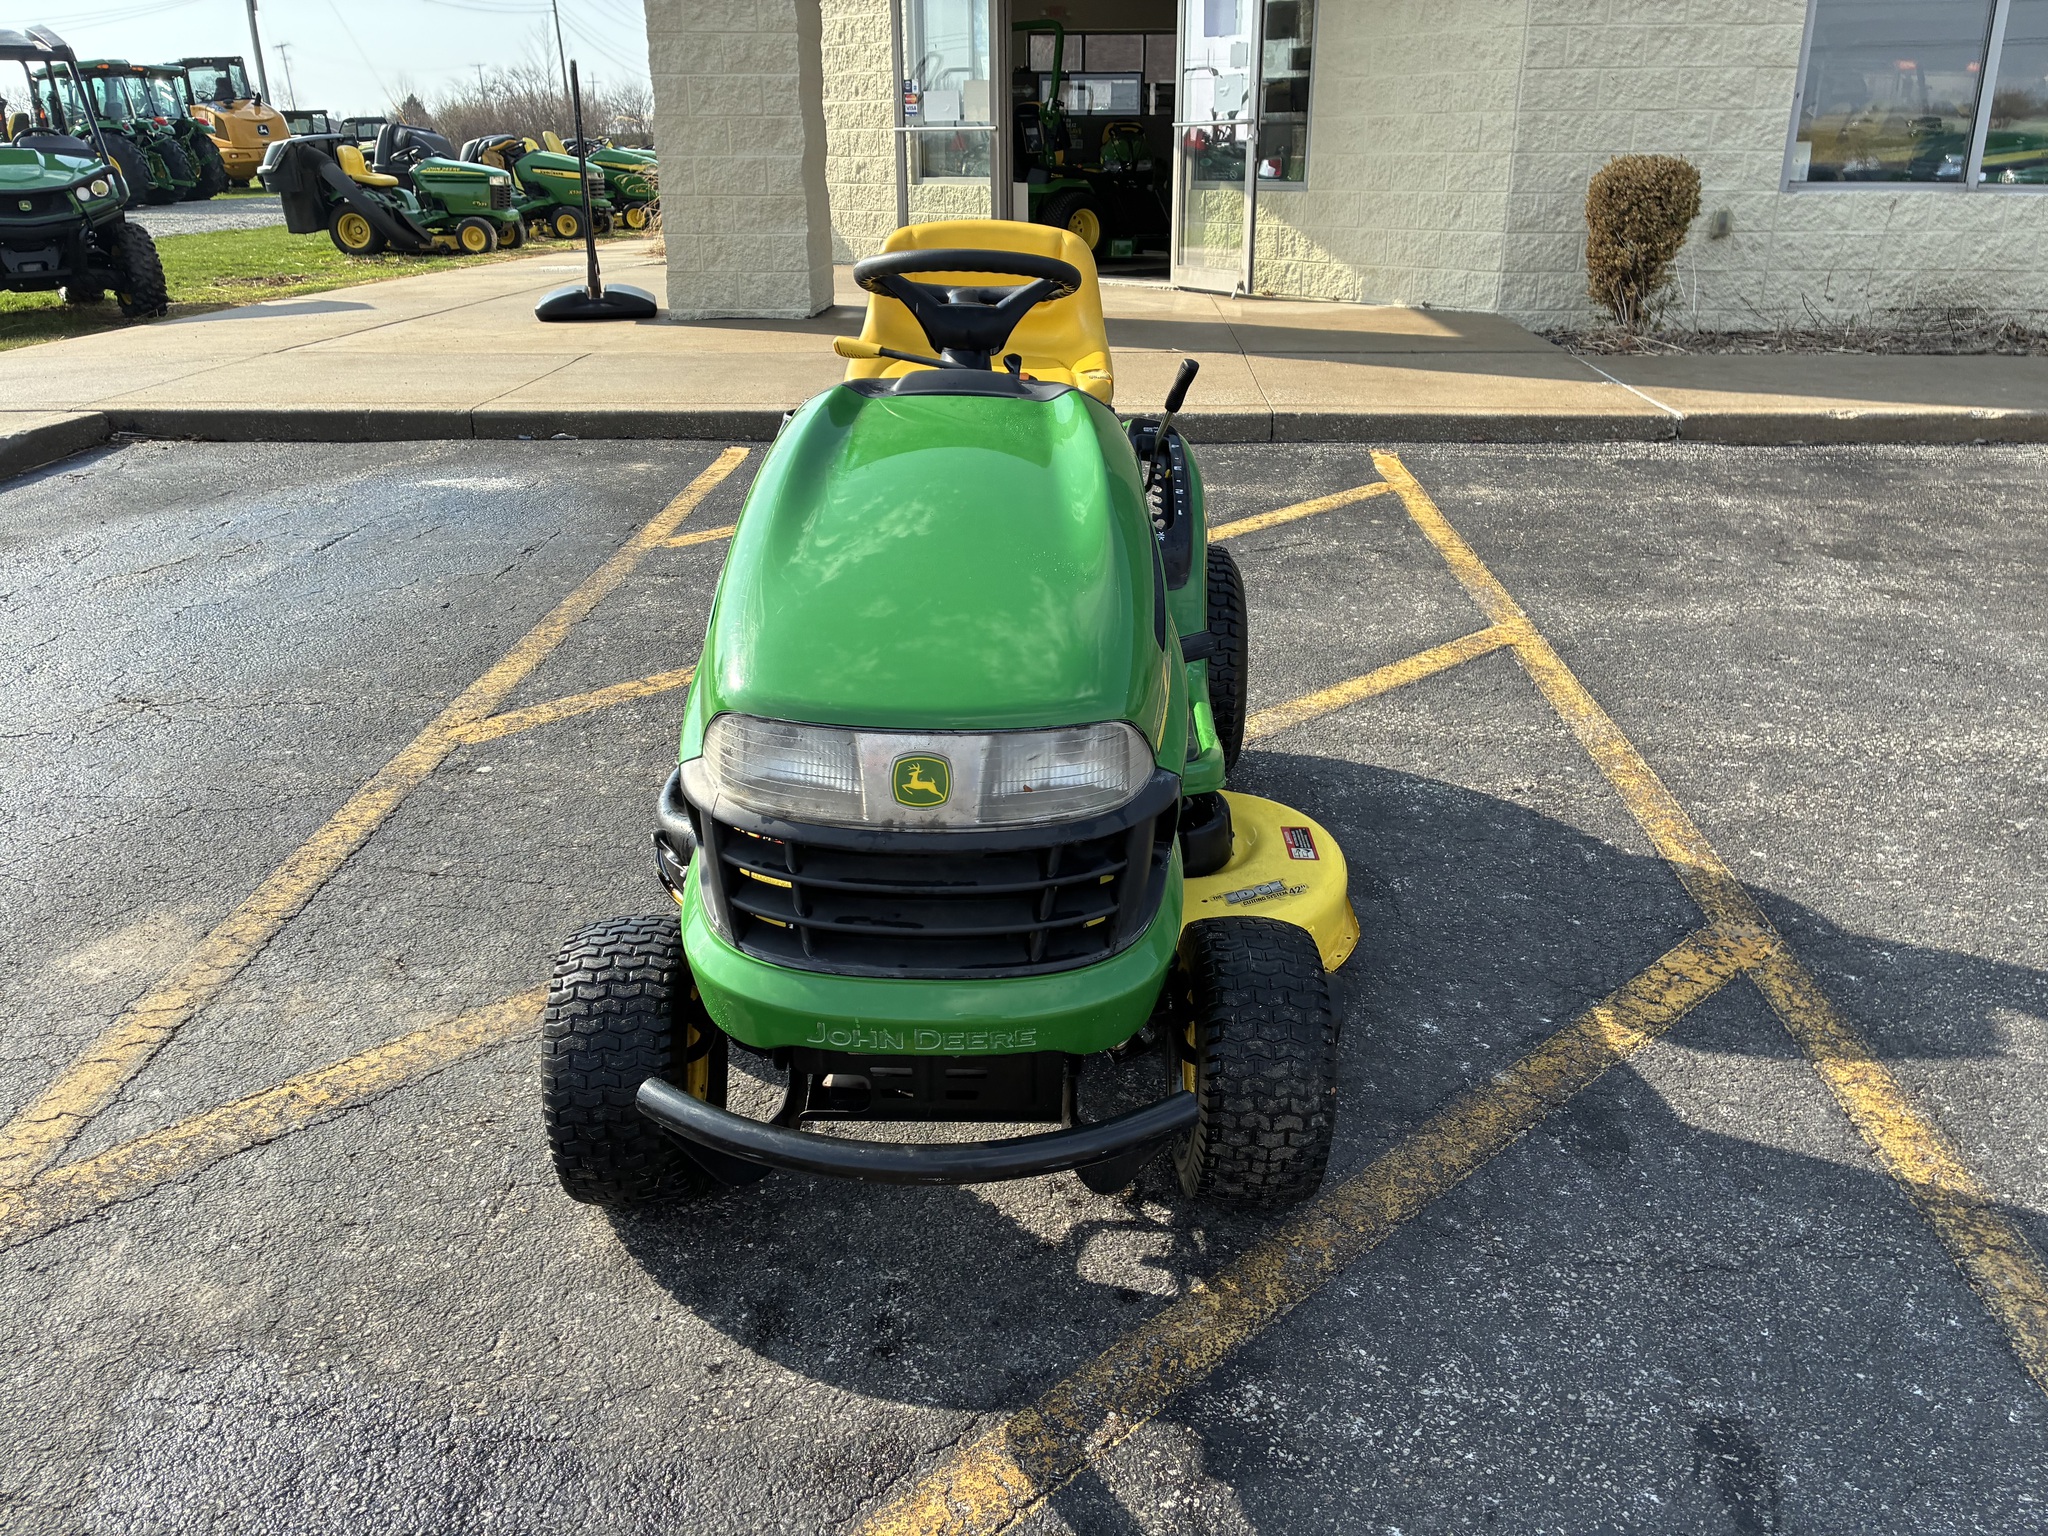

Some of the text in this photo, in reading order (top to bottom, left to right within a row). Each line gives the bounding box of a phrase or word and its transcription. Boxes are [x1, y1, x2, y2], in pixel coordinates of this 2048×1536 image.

[1224, 880, 1285, 904] EDGE
[1242, 890, 1288, 906] CUTTING SYSTEM
[1288, 884, 1306, 895] 42"
[806, 1021, 1037, 1051] JOHN DEERE
